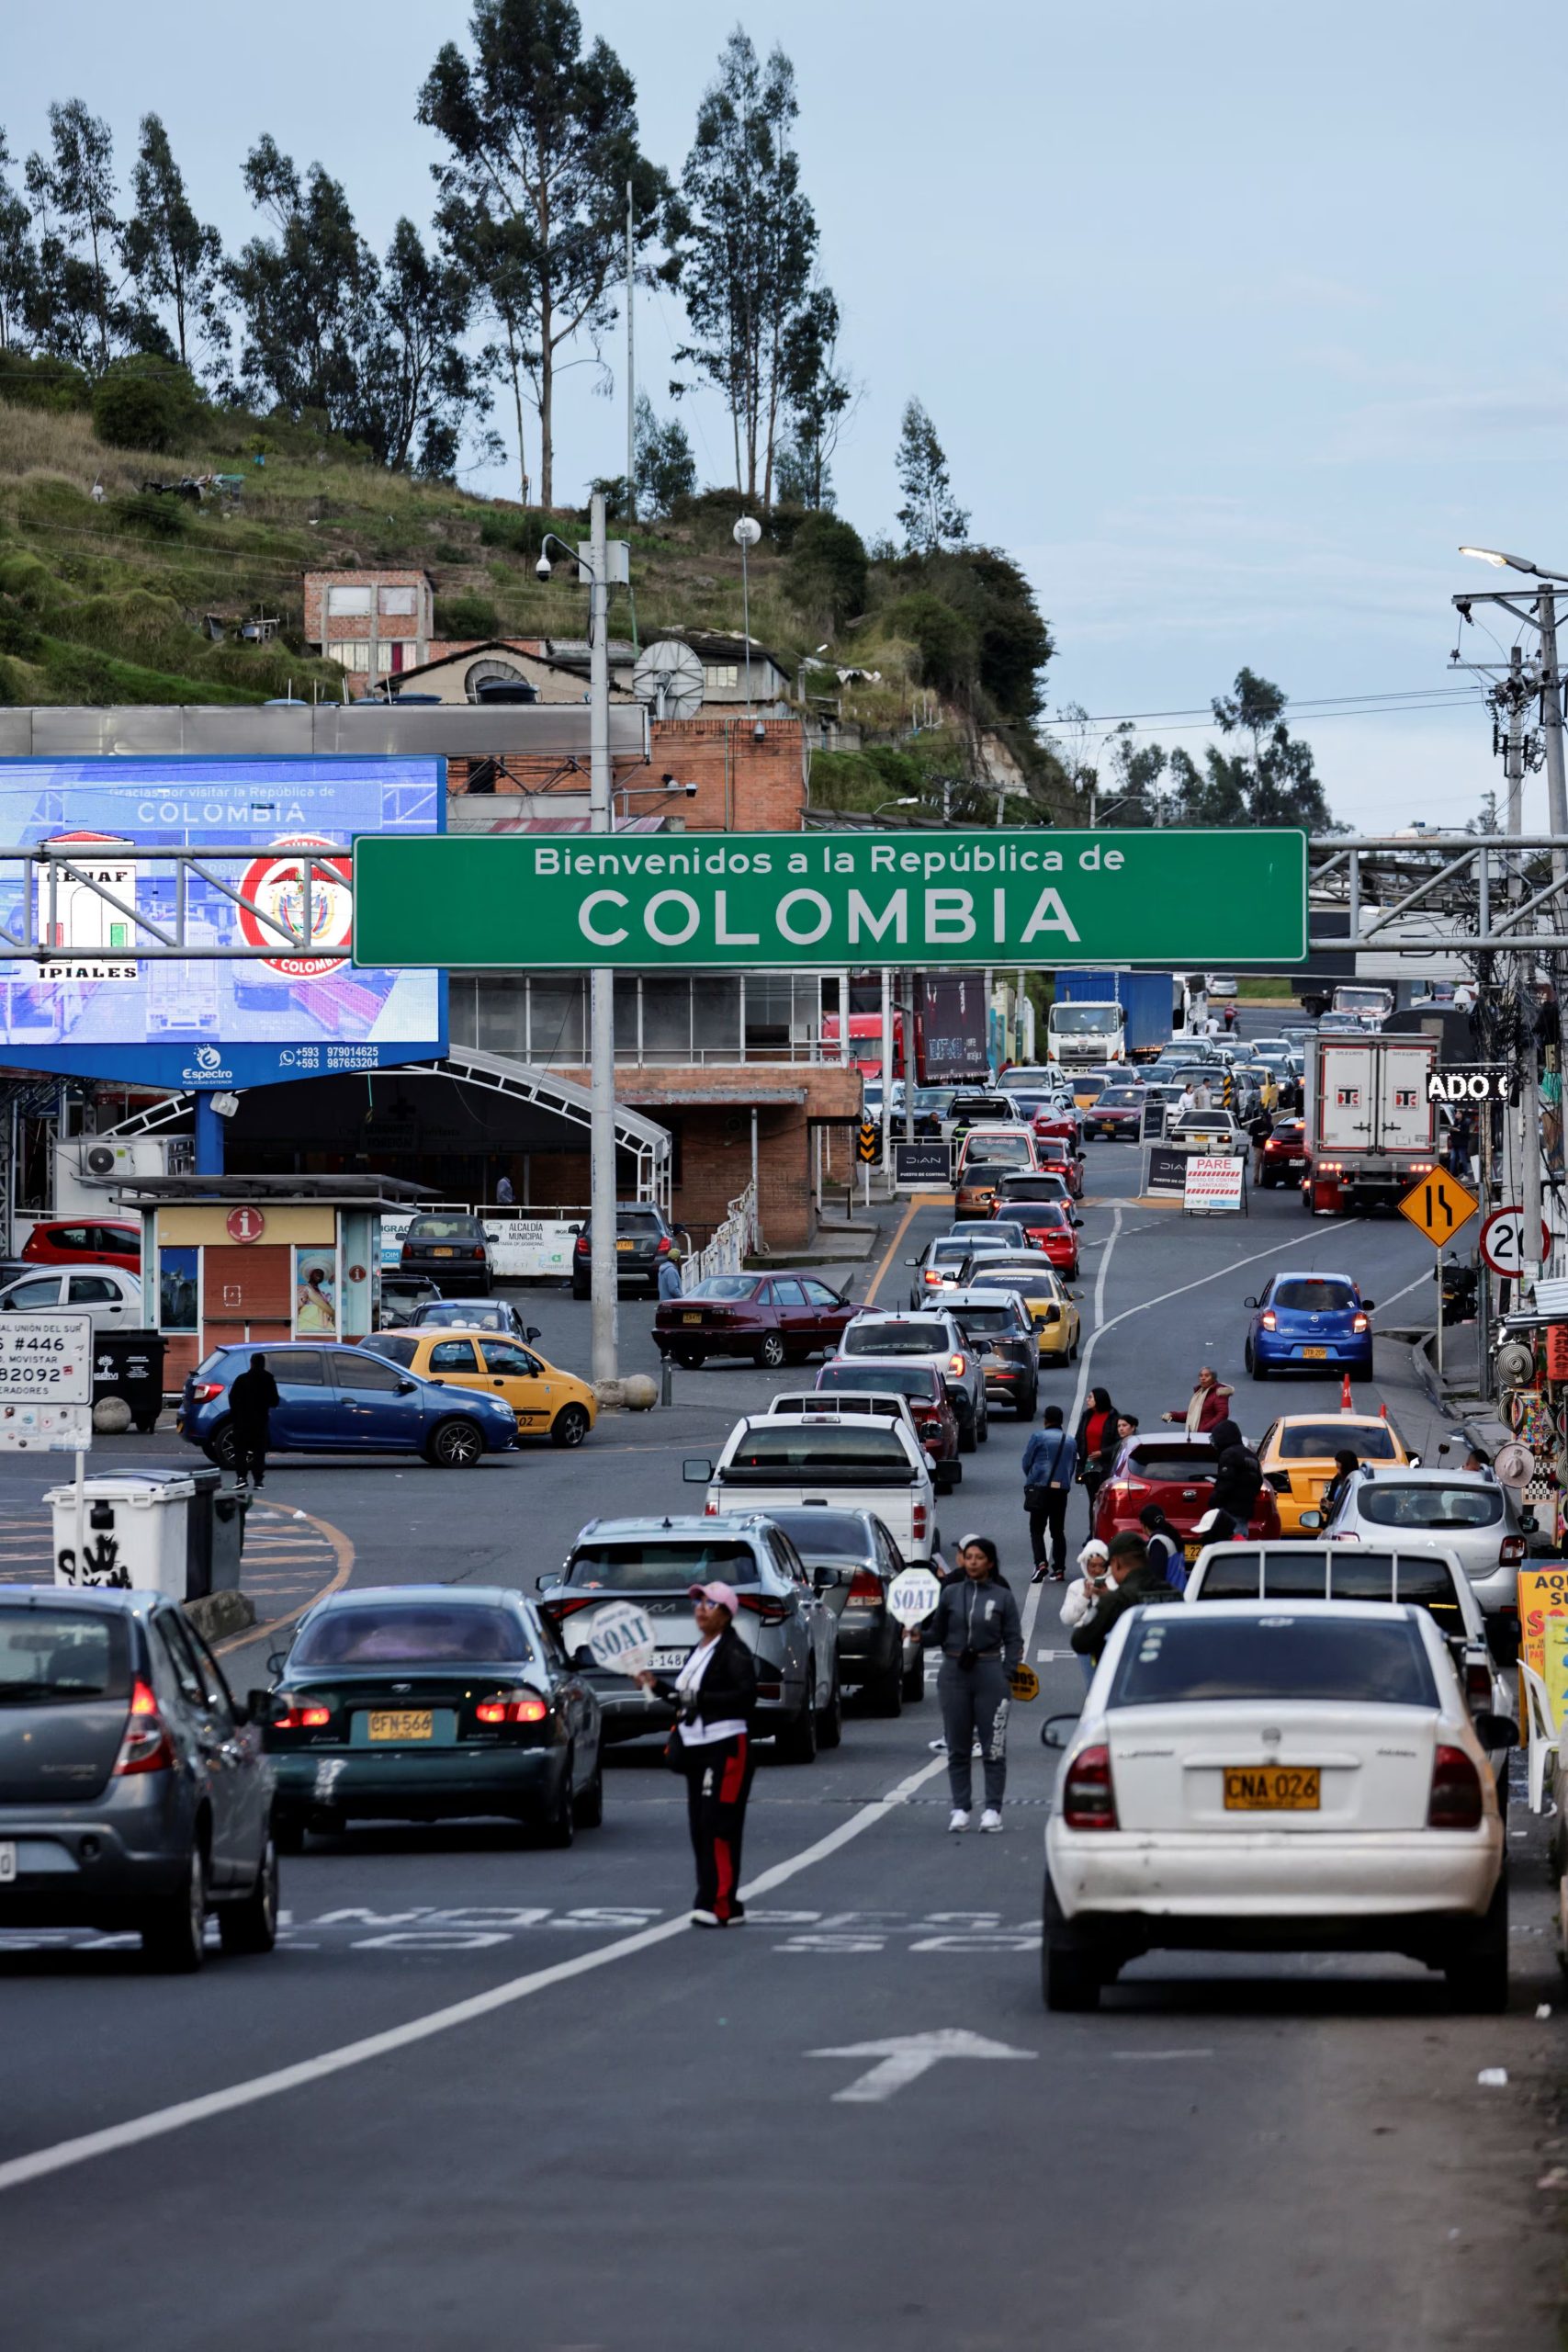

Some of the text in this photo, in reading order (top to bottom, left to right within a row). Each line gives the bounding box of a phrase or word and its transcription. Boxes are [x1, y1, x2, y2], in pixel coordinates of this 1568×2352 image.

[189, 787, 230, 797] visitar
[233, 787, 244, 797] la
[250, 786, 315, 799] República
[319, 786, 335, 797] de
[138, 801, 306, 823] COLOMBIA
[536, 843, 1125, 879] Bienvenidos a la República de
[578, 887, 1081, 947] COLOMBIA
[39, 967, 137, 978] IPIALES
[296, 1046, 378, 1057] +593 979014625
[296, 1057, 378, 1069] +593 987653204
[183, 1068, 232, 1080] Espectro
[1428, 1075, 1490, 1099] ADO
[1159, 1162, 1187, 1170] DIA
[1197, 1159, 1232, 1169] PARE
[509, 1221, 544, 1232] ALCALDÍA
[508, 1232, 544, 1240] MUNICIPAL
[1494, 1224, 1524, 1258] 2
[15, 1323, 41, 1332] UNIÓN
[15, 1337, 64, 1351] #446
[9, 1355, 58, 1363] MOVISTAR
[1535, 1576, 1568, 1590] AQ
[894, 1589, 937, 1610] SOAT
[591, 1615, 649, 1662] SOAT
